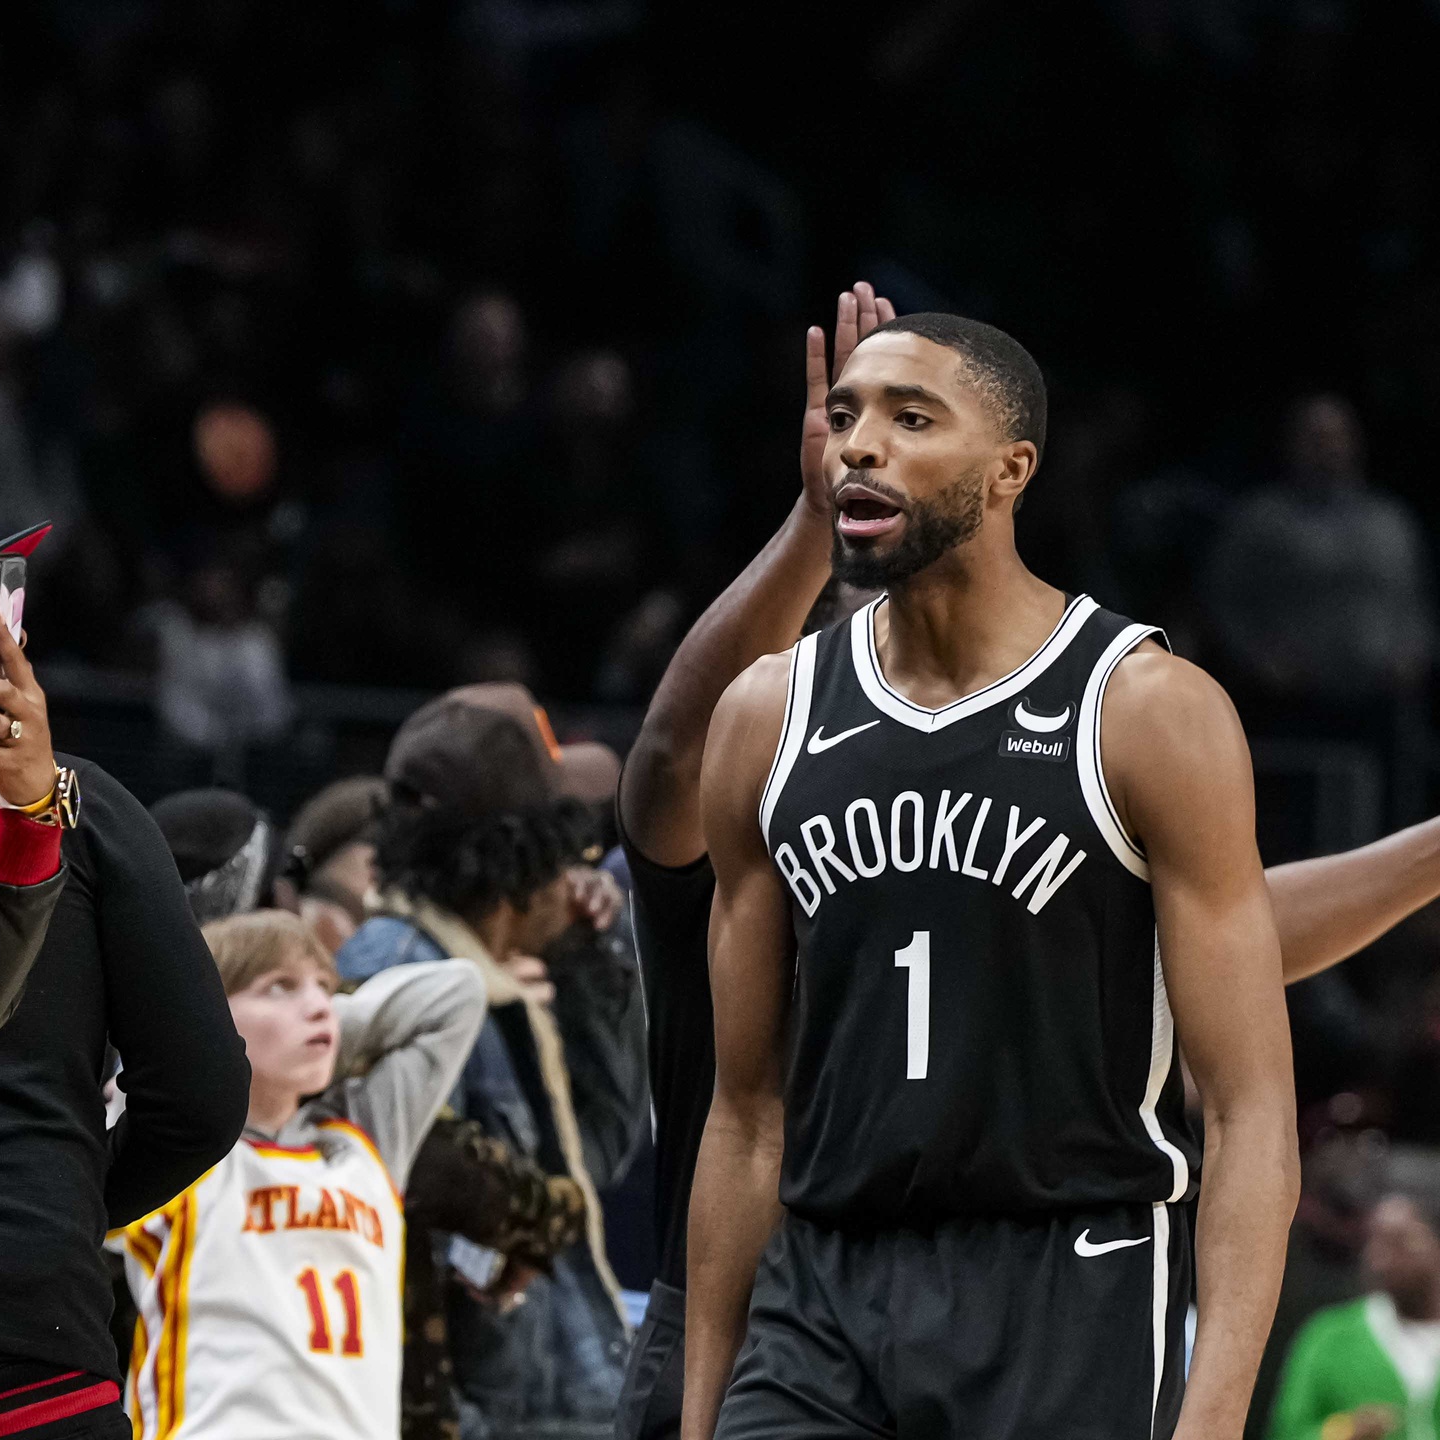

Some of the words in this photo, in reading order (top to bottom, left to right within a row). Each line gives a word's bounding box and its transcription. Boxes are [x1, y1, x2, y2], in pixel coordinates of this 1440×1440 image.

[1007, 737, 1063, 757] Webull
[774, 789, 1087, 918] BROOKLYN
[894, 930, 930, 1080] 1
[241, 1186, 384, 1249] TLATA
[297, 1268, 364, 1358] 11
